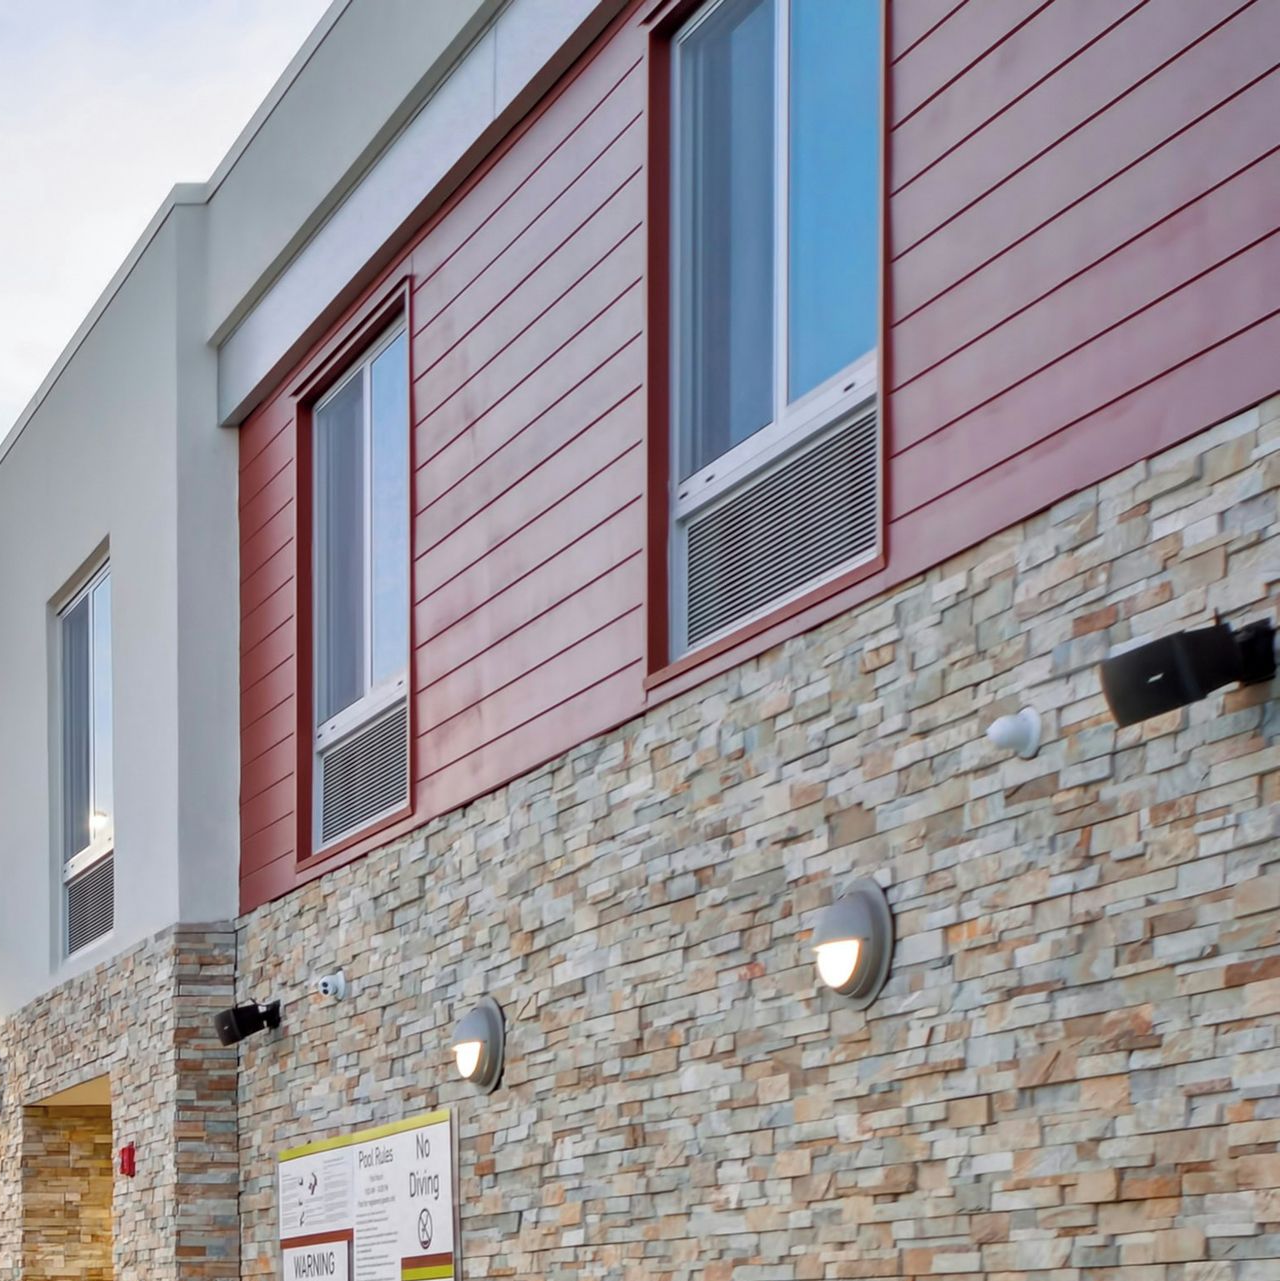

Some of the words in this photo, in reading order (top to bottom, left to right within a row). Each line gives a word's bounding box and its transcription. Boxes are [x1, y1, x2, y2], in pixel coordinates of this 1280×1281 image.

[359, 1149, 374, 1169] Pool
[375, 1146, 394, 1166] Rules
[416, 1133, 431, 1160] No
[409, 1169, 440, 1200] Diving
[293, 1251, 335, 1279] WARNING
